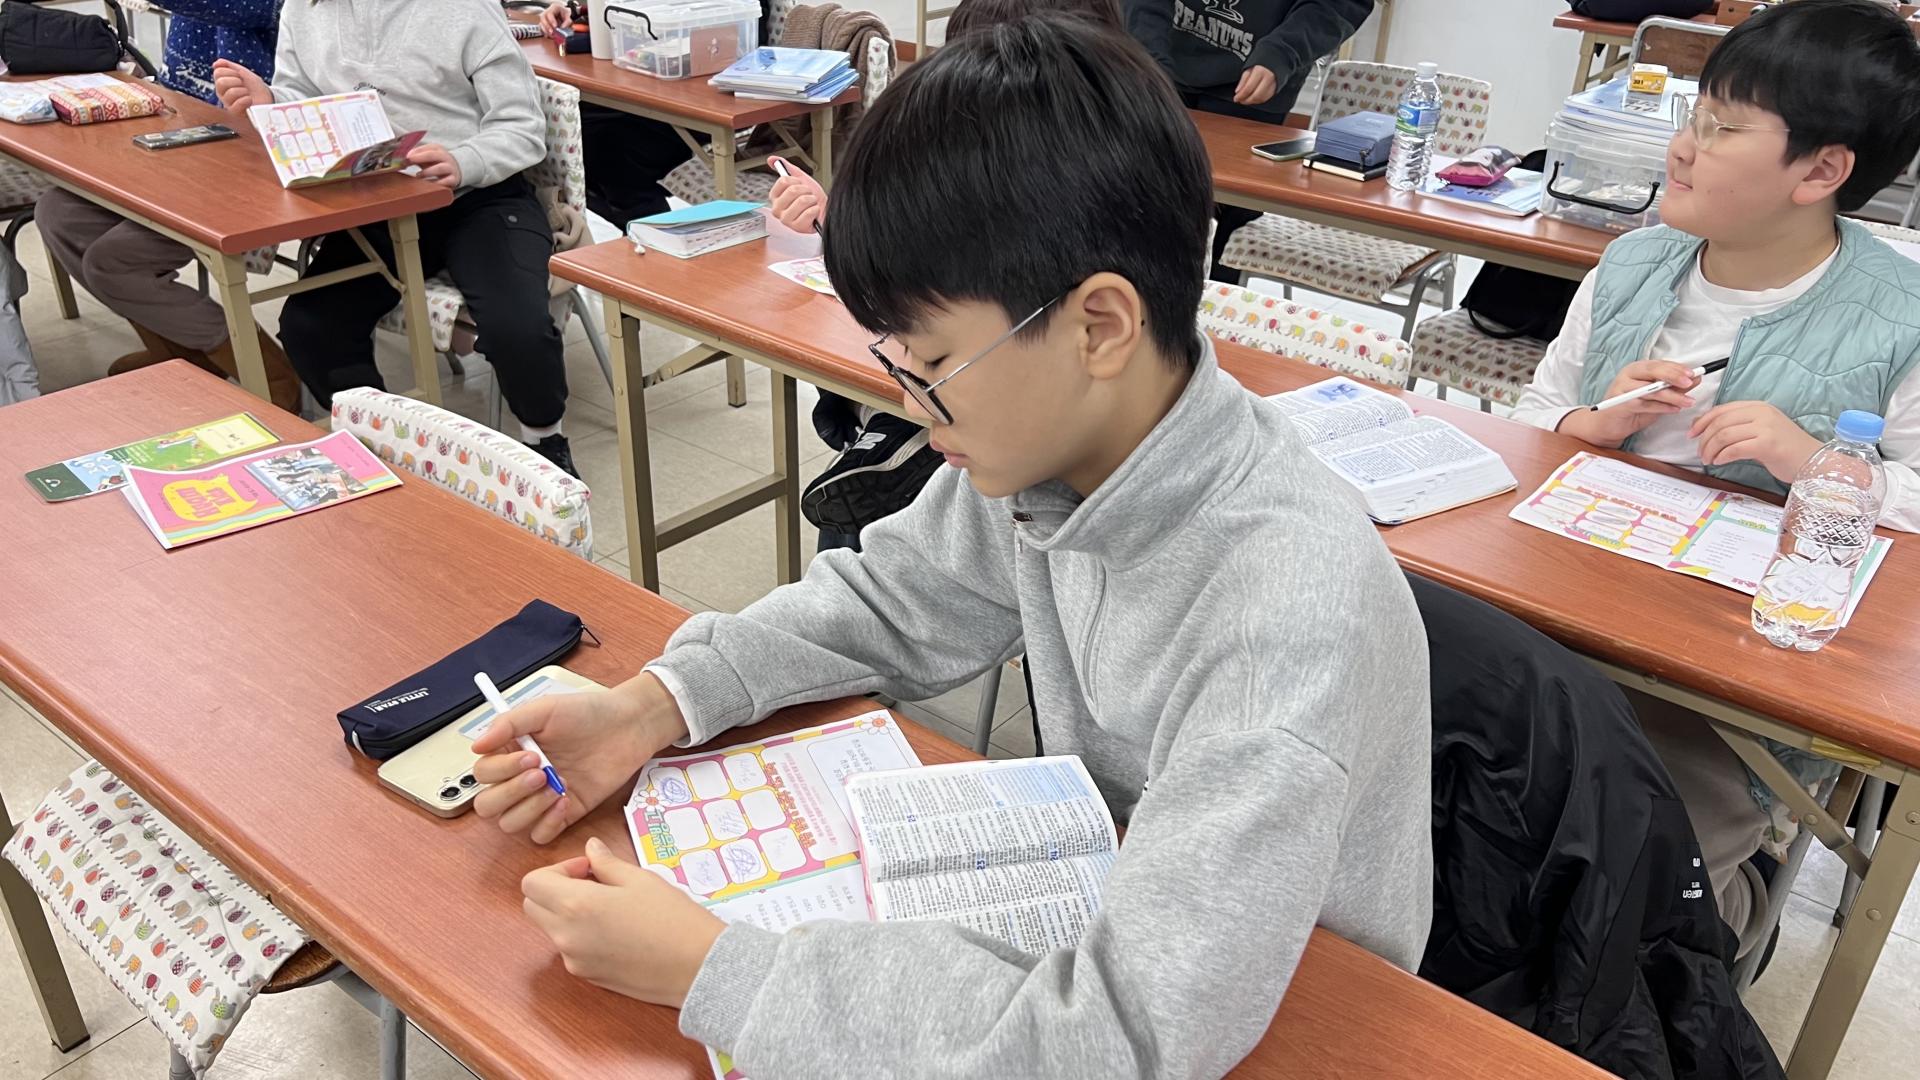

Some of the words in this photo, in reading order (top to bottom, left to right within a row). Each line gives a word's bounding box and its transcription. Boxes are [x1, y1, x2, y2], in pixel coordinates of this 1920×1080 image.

[1173, 0, 1254, 56] PEANUTS
[398, 690, 430, 704] LITTLE
[374, 700, 400, 712] STAR
[906, 814, 917, 823] 25
[645, 808, 679, 860] 말씀빙고
[1050, 850, 1059, 861] 24
[976, 859, 986, 870] 23
